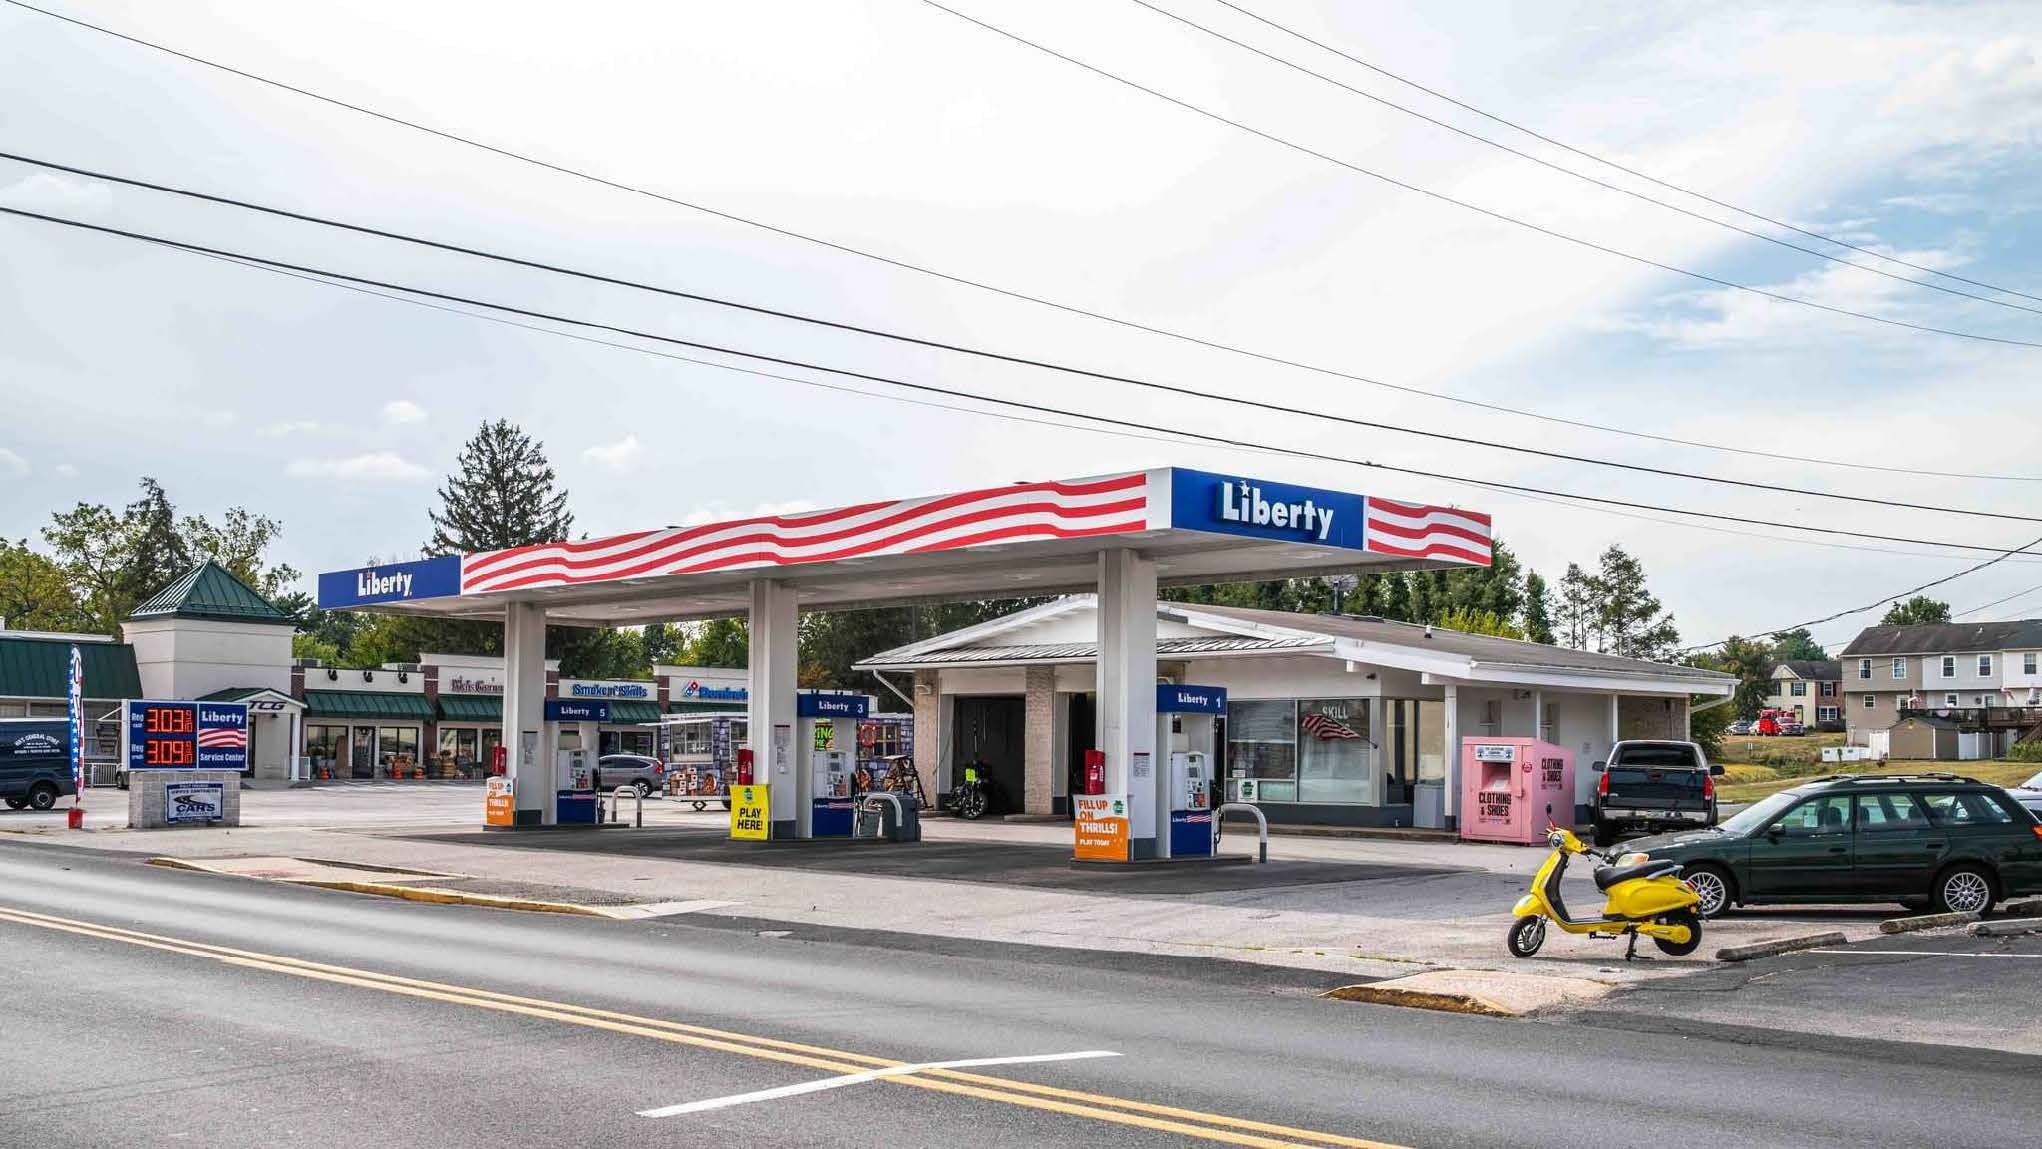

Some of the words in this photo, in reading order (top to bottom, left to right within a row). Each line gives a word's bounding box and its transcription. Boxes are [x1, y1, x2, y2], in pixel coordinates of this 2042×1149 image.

[1221, 479, 1335, 540] Liberty
[357, 570, 413, 597] Liberty
[249, 701, 287, 711] TCG
[819, 701, 849, 712] Liberty
[857, 704, 863, 713] 3
[1178, 693, 1208, 706] Liberty
[1216, 696, 1221, 708] 1
[201, 711, 243, 724] Liberty
[561, 706, 590, 716] Liberty
[600, 709, 605, 717] 5
[1322, 705, 1348, 719] SKILL
[147, 708, 184, 733] 3.03
[147, 740, 184, 764] 3.09
[200, 753, 224, 762] Service
[225, 753, 245, 762] Center
[1479, 791, 1512, 805] CLOTHING
[176, 804, 215, 813] CARS
[1079, 800, 1095, 810] FILL
[1096, 800, 1108, 810] UP
[1487, 804, 1509, 817] SHOES
[739, 807, 762, 818] PLAY
[737, 819, 763, 831] HERE!
[1079, 822, 1118, 835] THRILLS!
